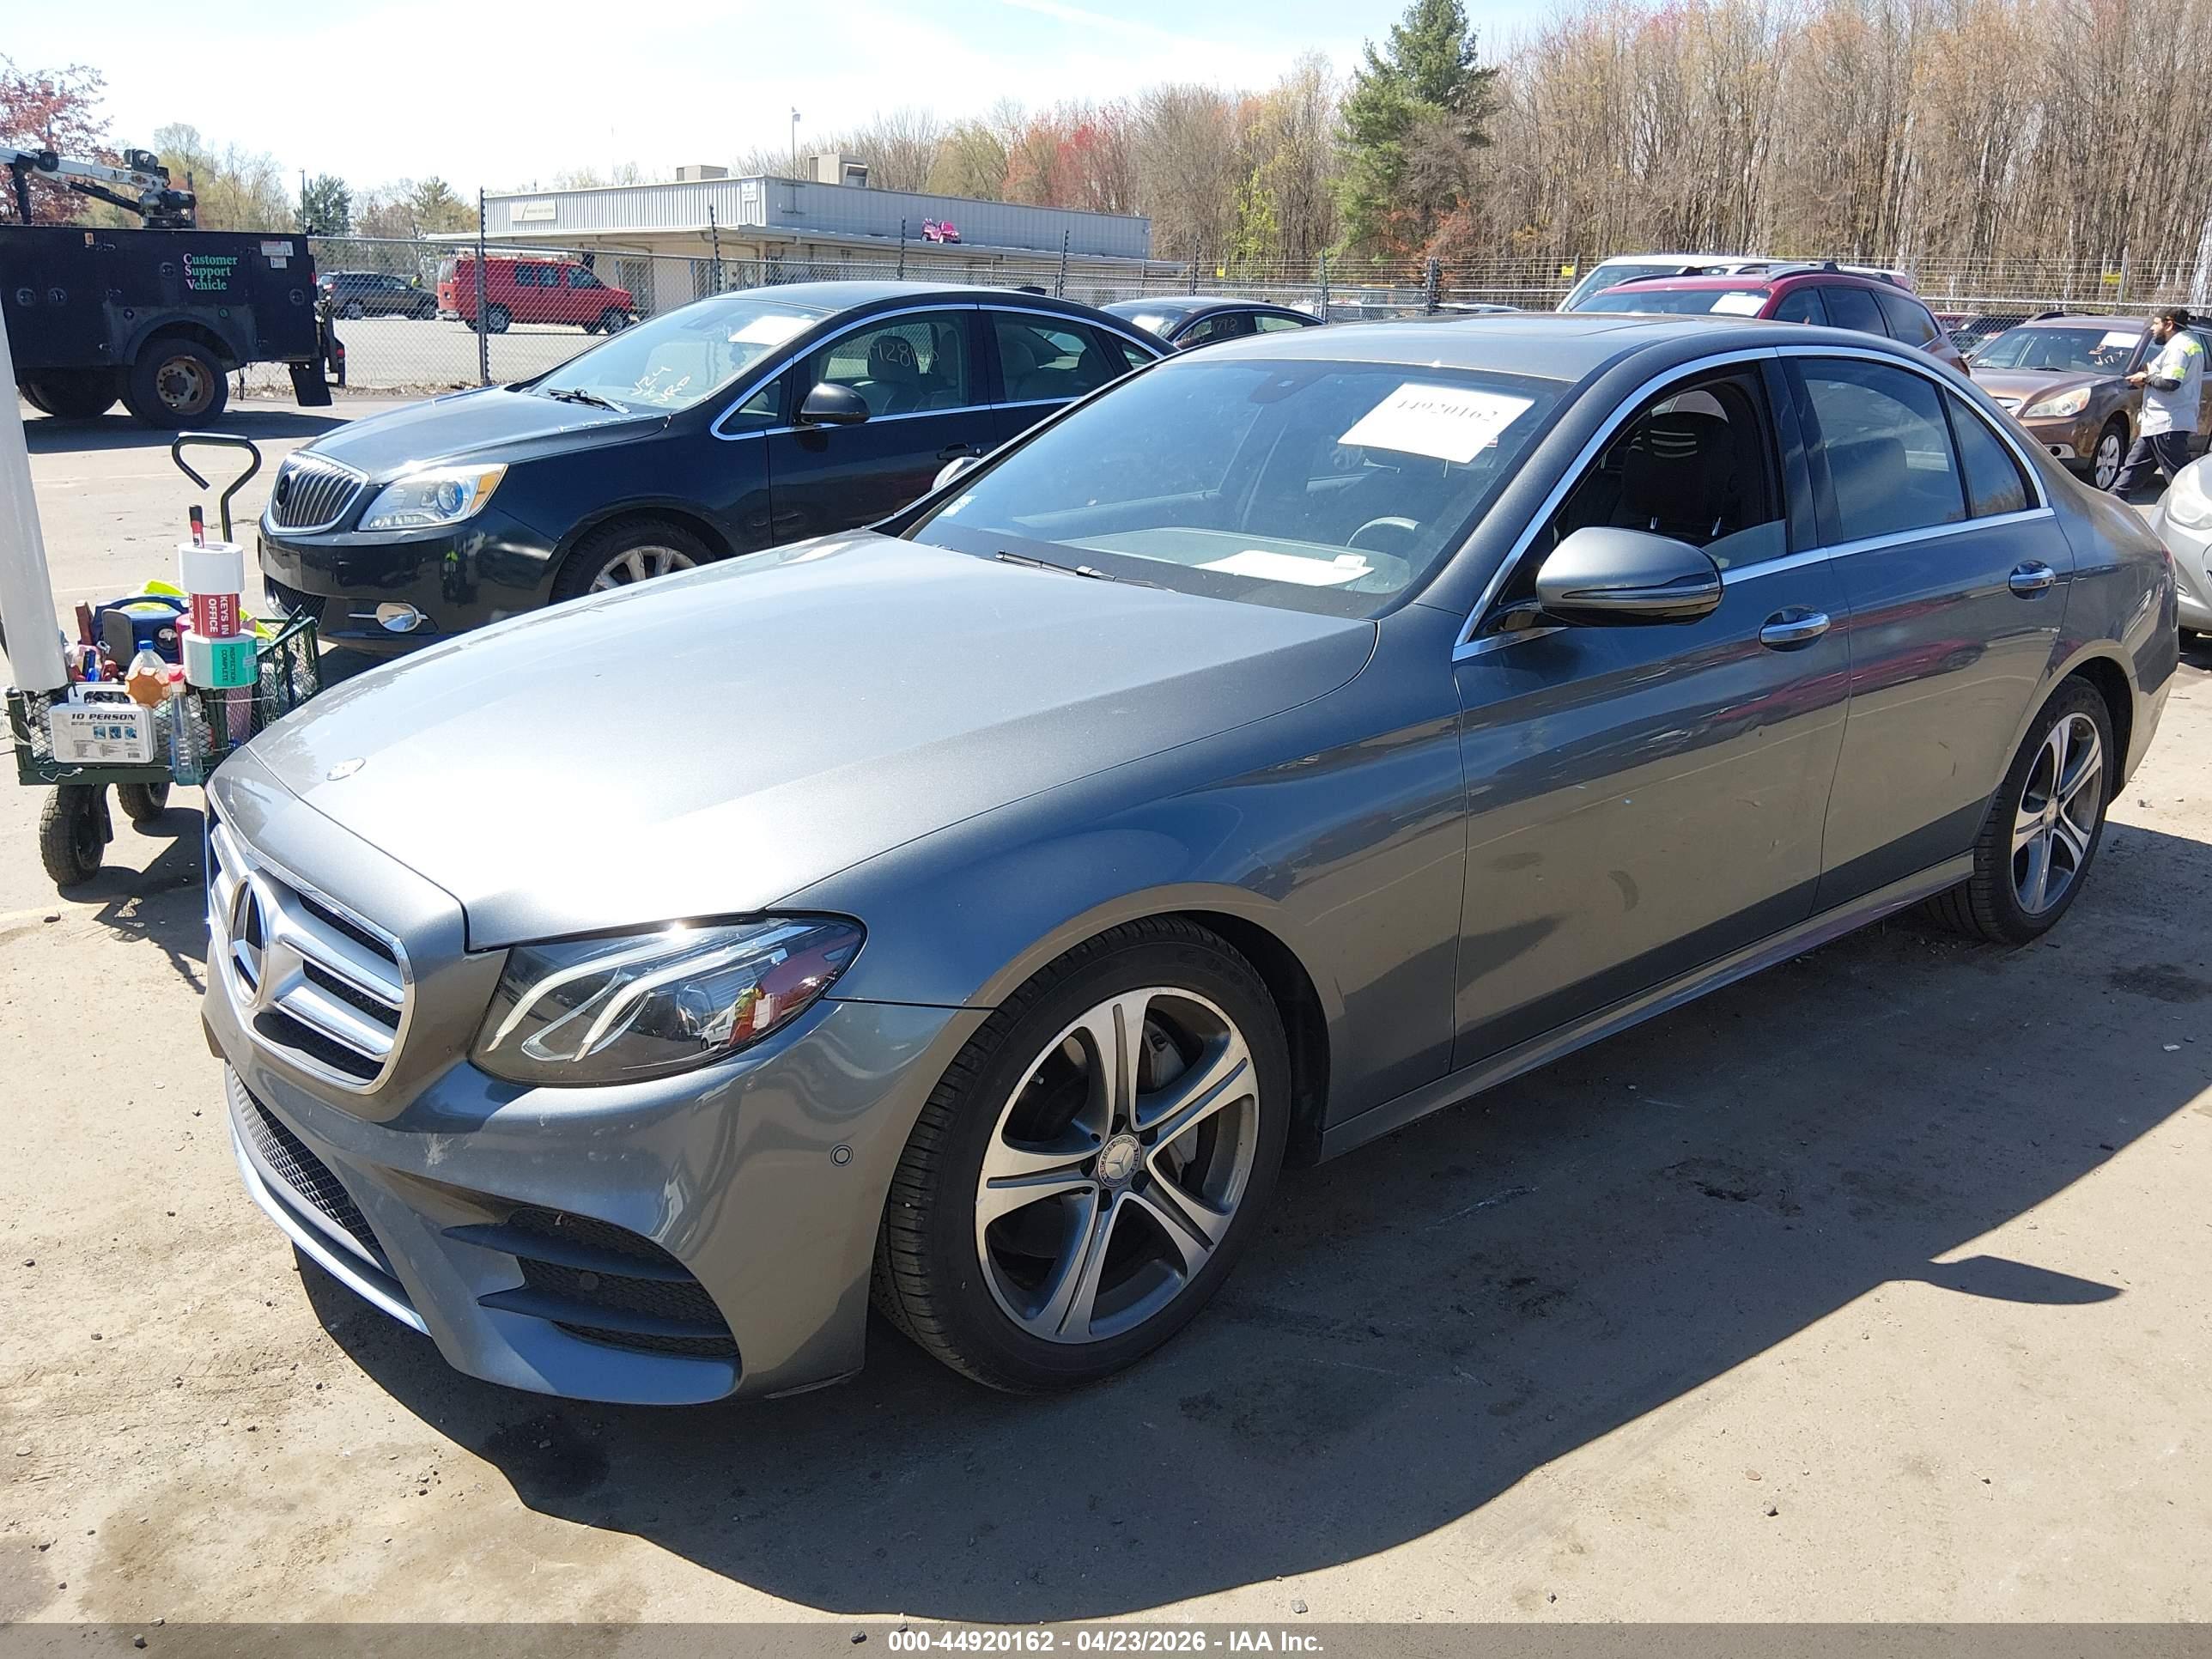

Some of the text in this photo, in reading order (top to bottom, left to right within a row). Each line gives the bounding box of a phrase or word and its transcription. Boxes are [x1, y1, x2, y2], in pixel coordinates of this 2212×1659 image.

[183, 253, 238, 265] Customer
[185, 265, 232, 279] Support
[185, 278, 227, 290] Vehicle
[209, 598, 219, 633] OFFICE
[220, 595, 229, 635] KEYS IN
